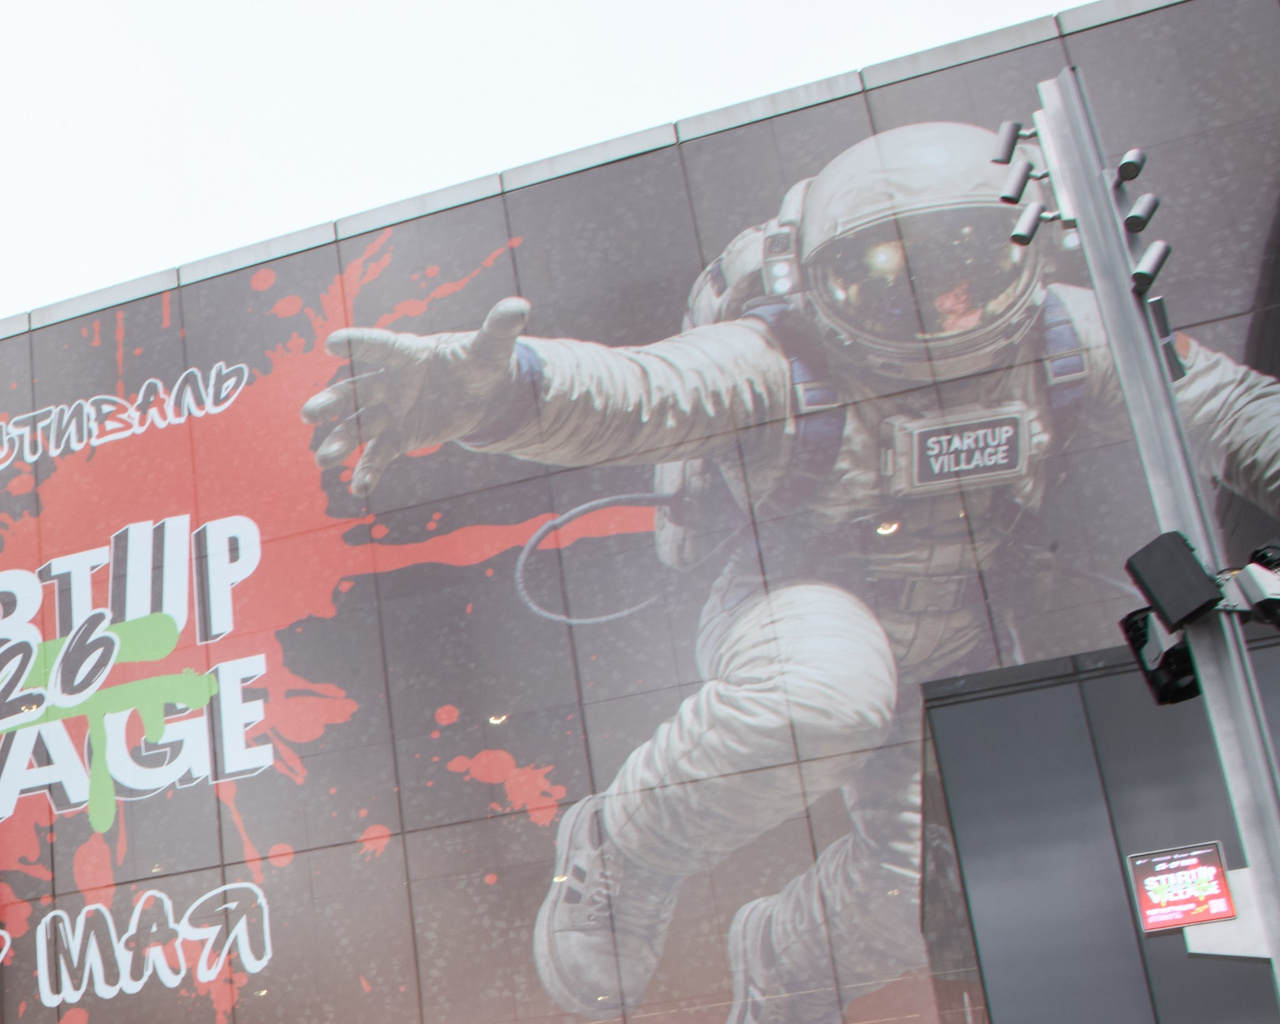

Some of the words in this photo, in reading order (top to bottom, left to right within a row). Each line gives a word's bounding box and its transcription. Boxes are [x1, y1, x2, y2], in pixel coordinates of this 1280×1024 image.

[926, 425, 1014, 456] STARTUP
[929, 445, 1010, 475] VILLAGE
[36, 883, 272, 1007] МАЯ
